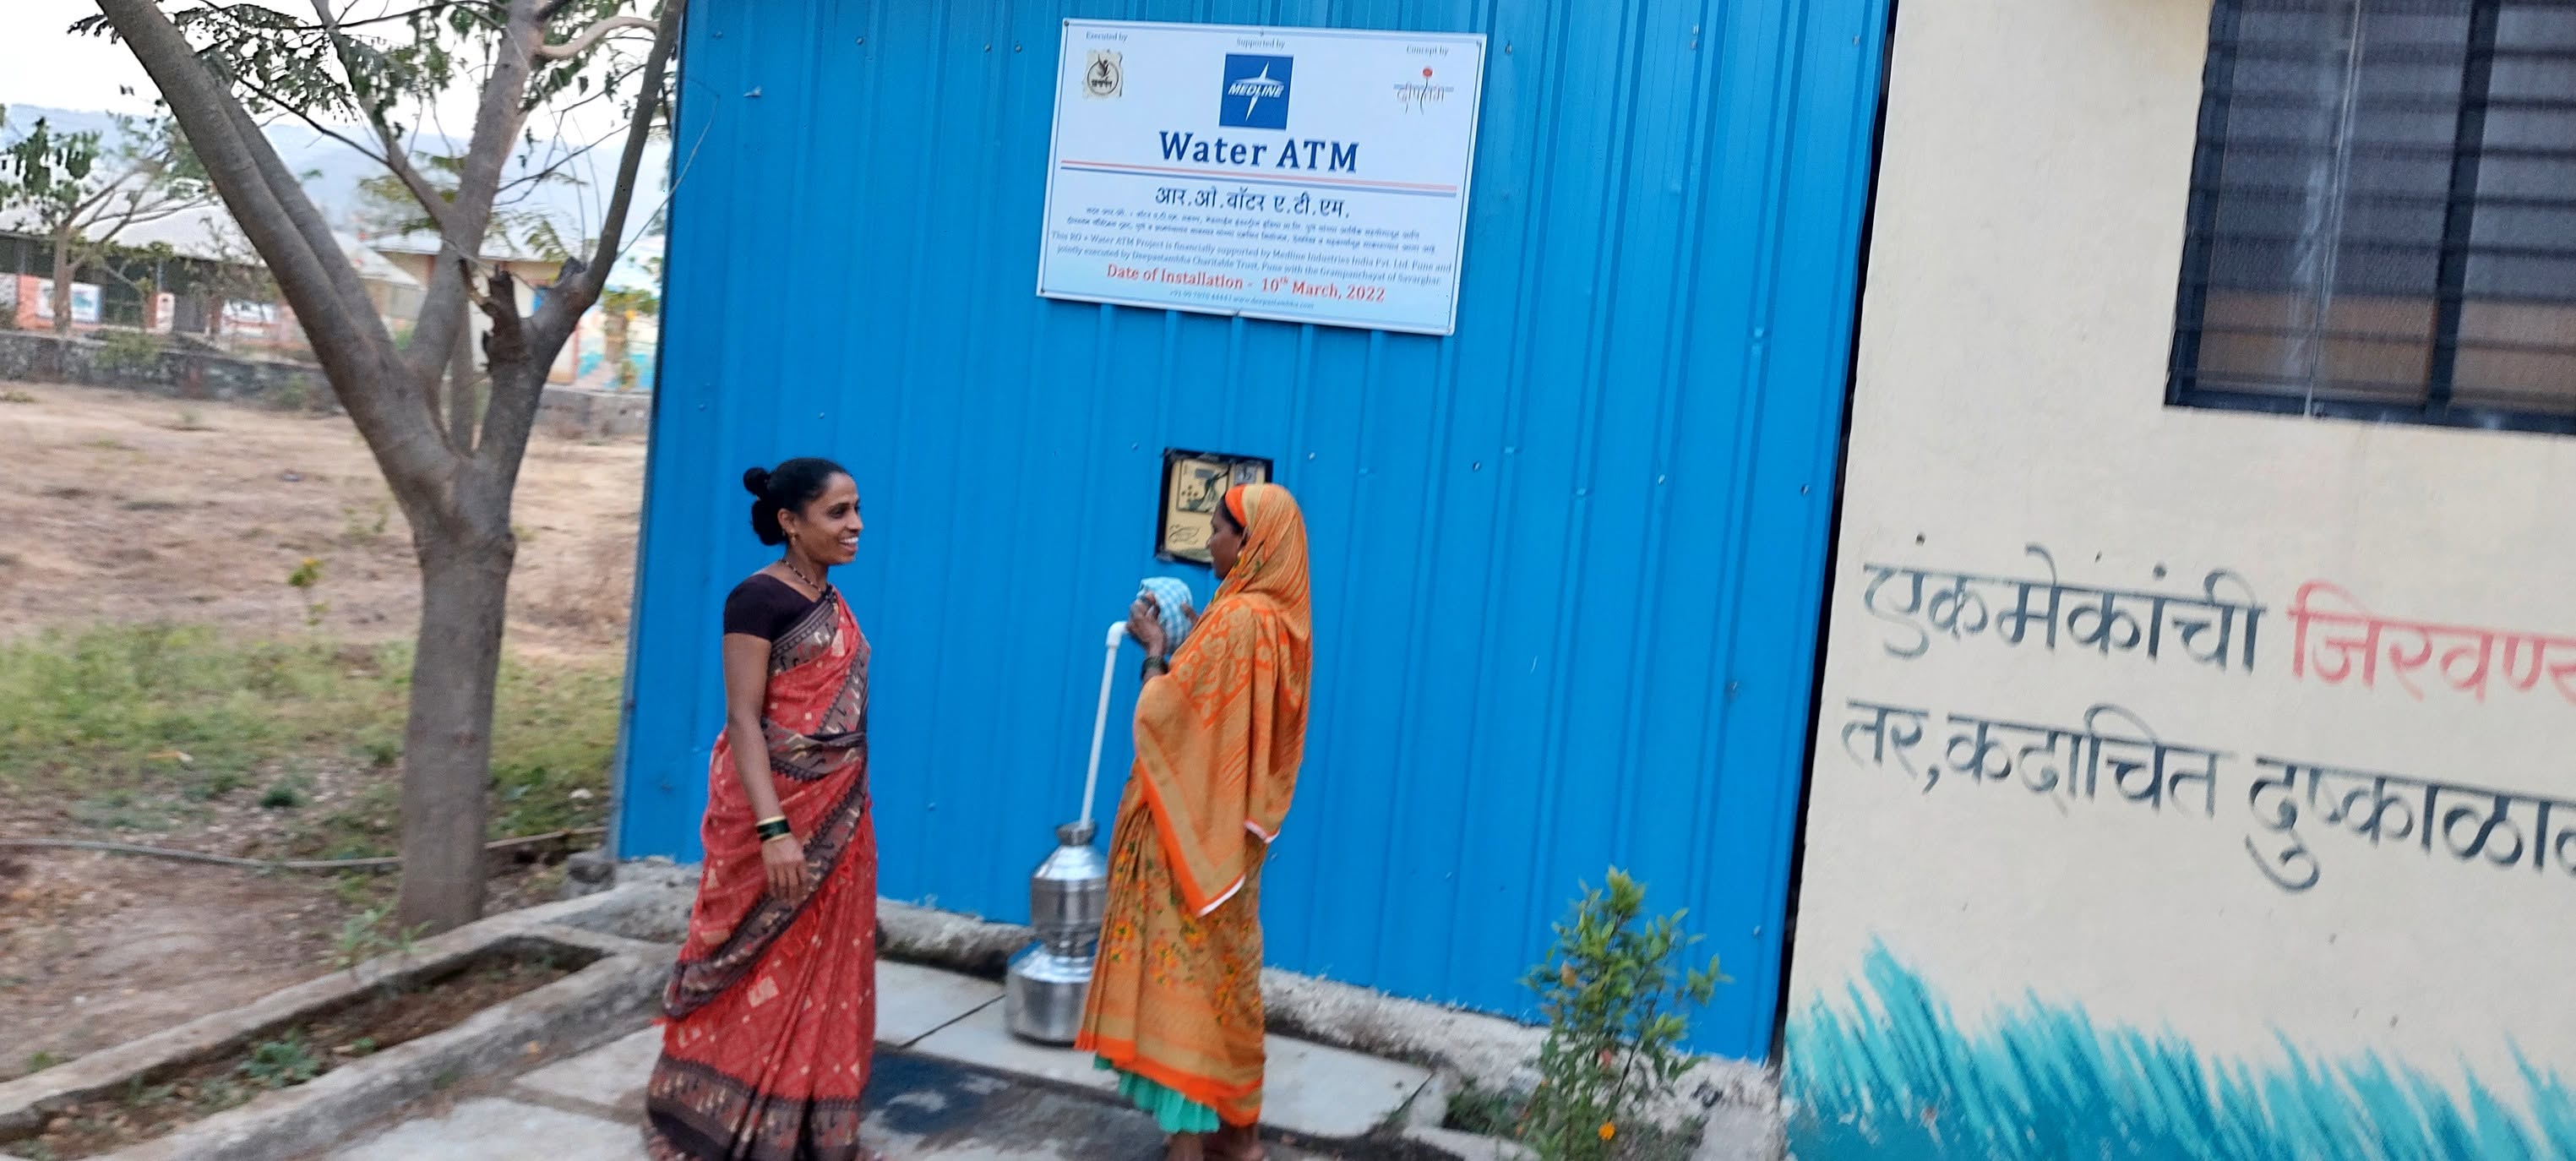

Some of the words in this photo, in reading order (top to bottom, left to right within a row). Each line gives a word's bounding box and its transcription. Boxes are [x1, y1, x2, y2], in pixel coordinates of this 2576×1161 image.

[1086, 30, 1118, 41] Executed
[1119, 32, 1128, 43] by
[1237, 38, 1275, 49] Supported
[1277, 39, 1285, 51] by
[1406, 45, 1437, 57] Concept
[1439, 46, 1449, 59] by
[1228, 83, 1284, 98] MEDLINE
[1159, 130, 1268, 167] Water
[1276, 138, 1359, 174] ATM
[1085, 248, 1119, 258] executed
[1120, 249, 1130, 261] by
[1192, 256, 1234, 268] Charitable
[1284, 264, 1303, 275] with
[1304, 265, 1318, 275] the
[1091, 233, 1114, 244] Water
[1115, 236, 1135, 246] ATM
[1136, 237, 1163, 249] Project
[1165, 240, 1172, 249] is
[1174, 242, 1216, 255] financially
[1217, 245, 1259, 257] supported
[1261, 248, 1271, 260] by
[1272, 249, 1305, 261] Medline
[1307, 251, 1350, 264] Industries
[1352, 256, 1373, 266] India
[1435, 261, 1451, 272] and
[1107, 263, 1140, 280] Date
[1142, 266, 1158, 282] of
[1161, 268, 1244, 290] Installation
[1292, 280, 1342, 302] March,
[1346, 284, 1386, 303] 2022
